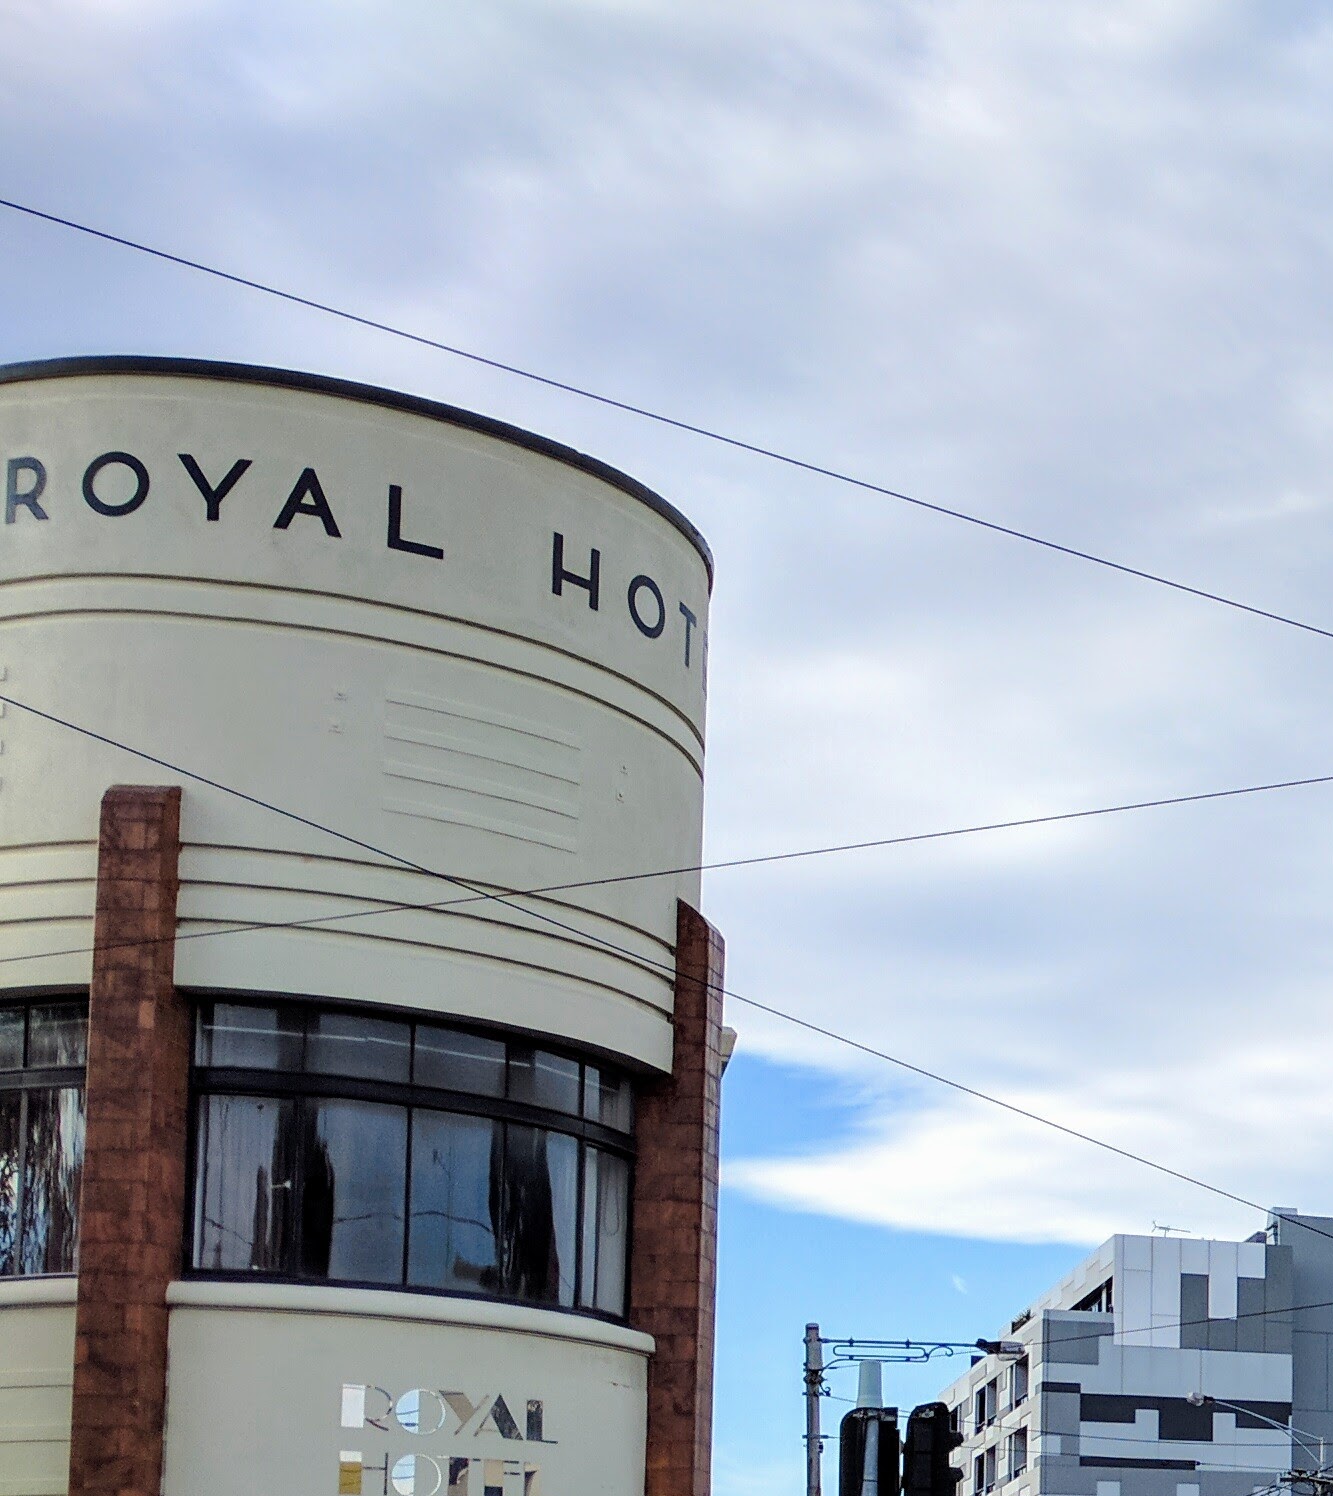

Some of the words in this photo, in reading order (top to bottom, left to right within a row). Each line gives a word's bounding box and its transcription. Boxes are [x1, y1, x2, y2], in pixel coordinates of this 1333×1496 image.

[5, 451, 444, 560] ROYAL
[553, 531, 707, 690] HOT
[341, 1384, 558, 1444] ROYAL
